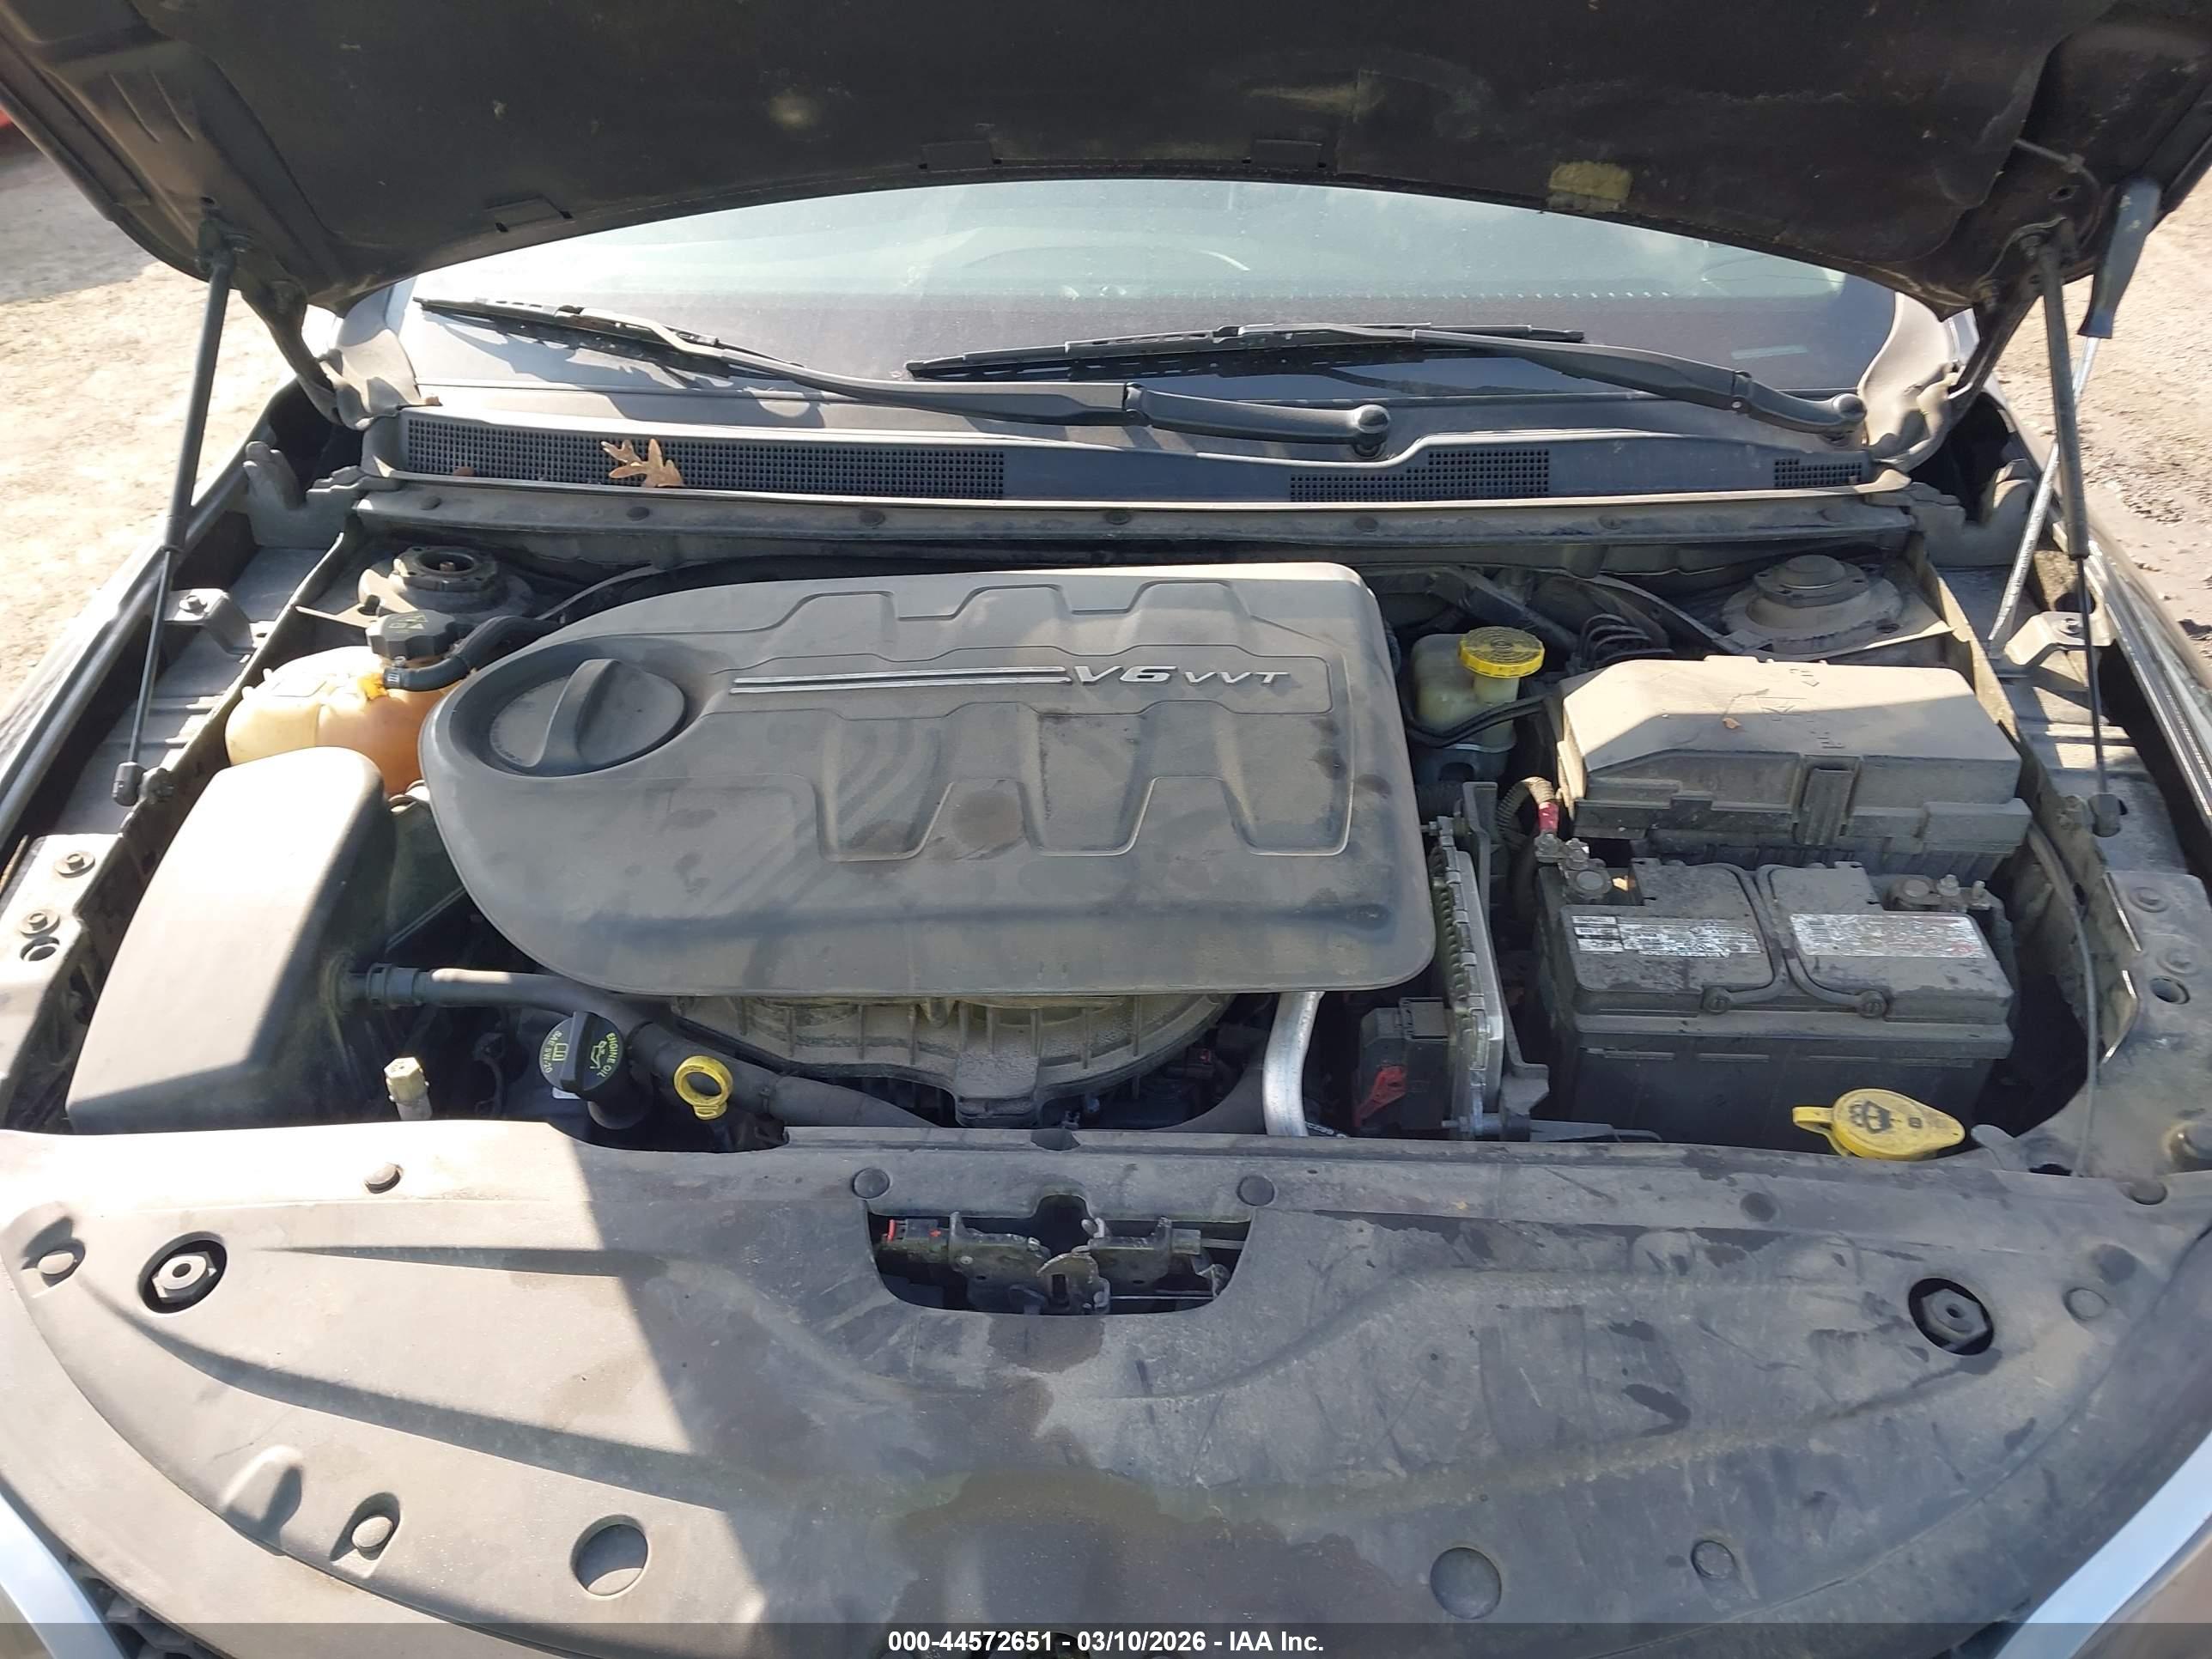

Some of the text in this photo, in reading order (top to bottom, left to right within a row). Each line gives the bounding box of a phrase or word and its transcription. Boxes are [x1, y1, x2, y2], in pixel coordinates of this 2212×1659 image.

[1073, 665, 1291, 685] V6 VVT
[596, 1032, 619, 1078] ENGINE OIL
